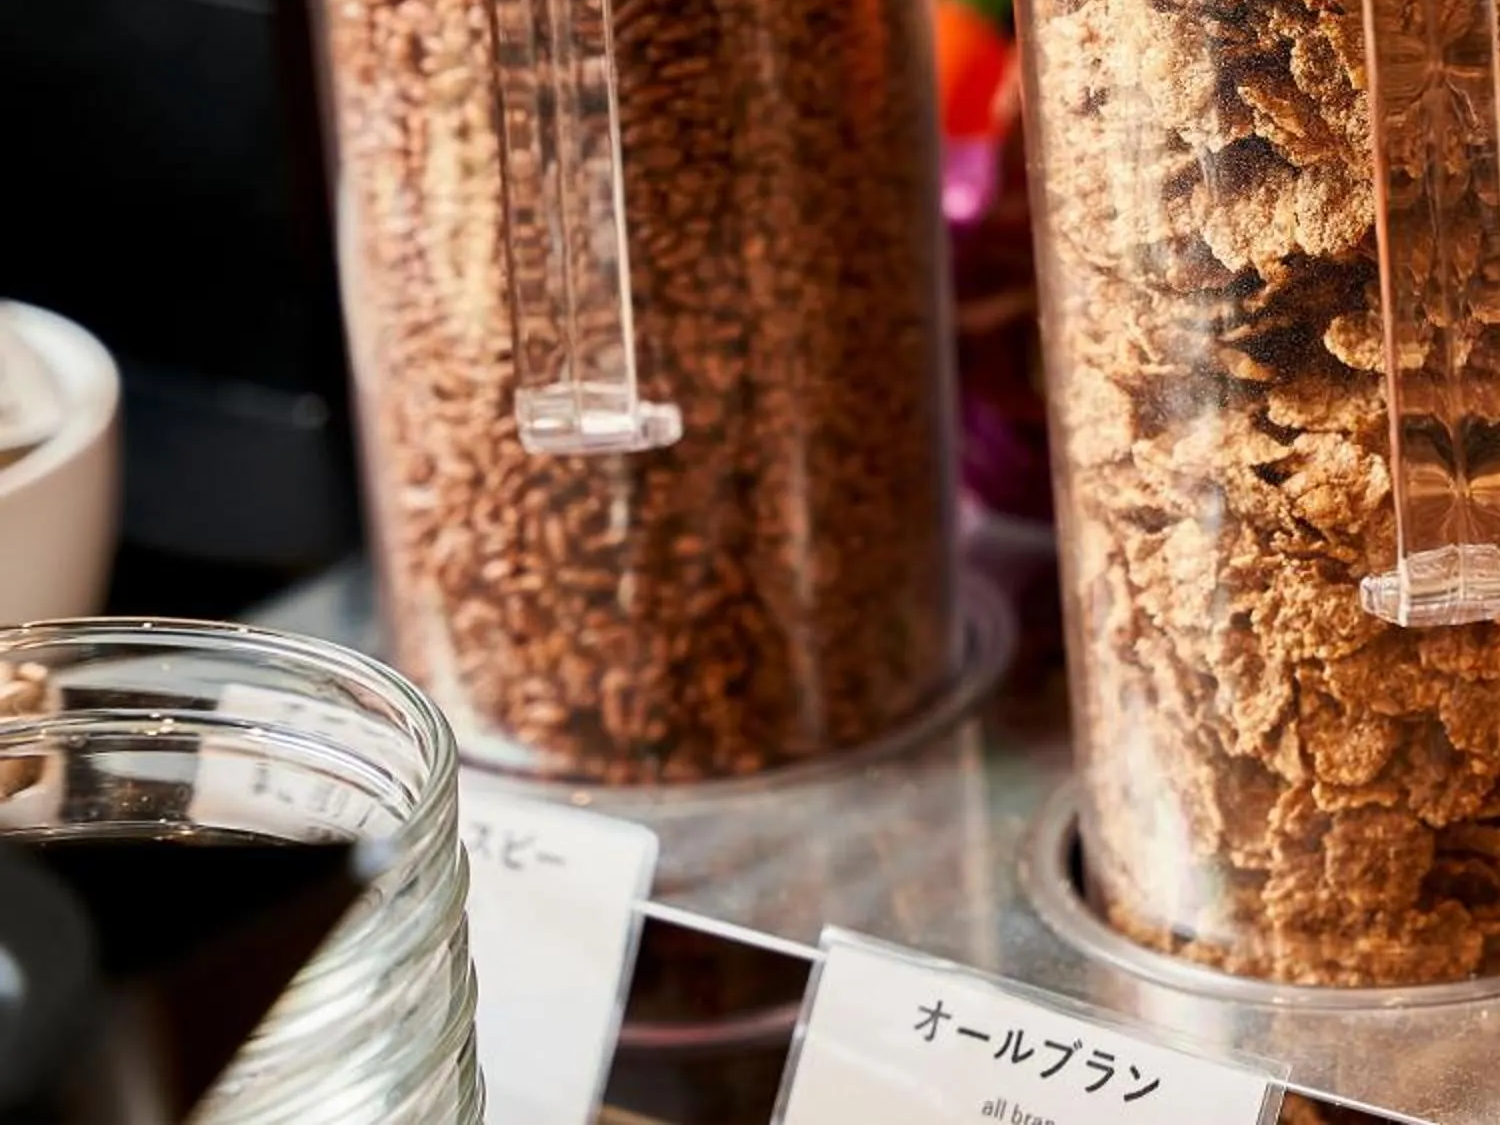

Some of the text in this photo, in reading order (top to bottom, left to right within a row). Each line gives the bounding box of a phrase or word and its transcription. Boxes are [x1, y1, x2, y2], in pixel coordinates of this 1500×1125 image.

[913, 1000, 1160, 1102] オールブラン
[981, 1098, 1007, 1120] all
